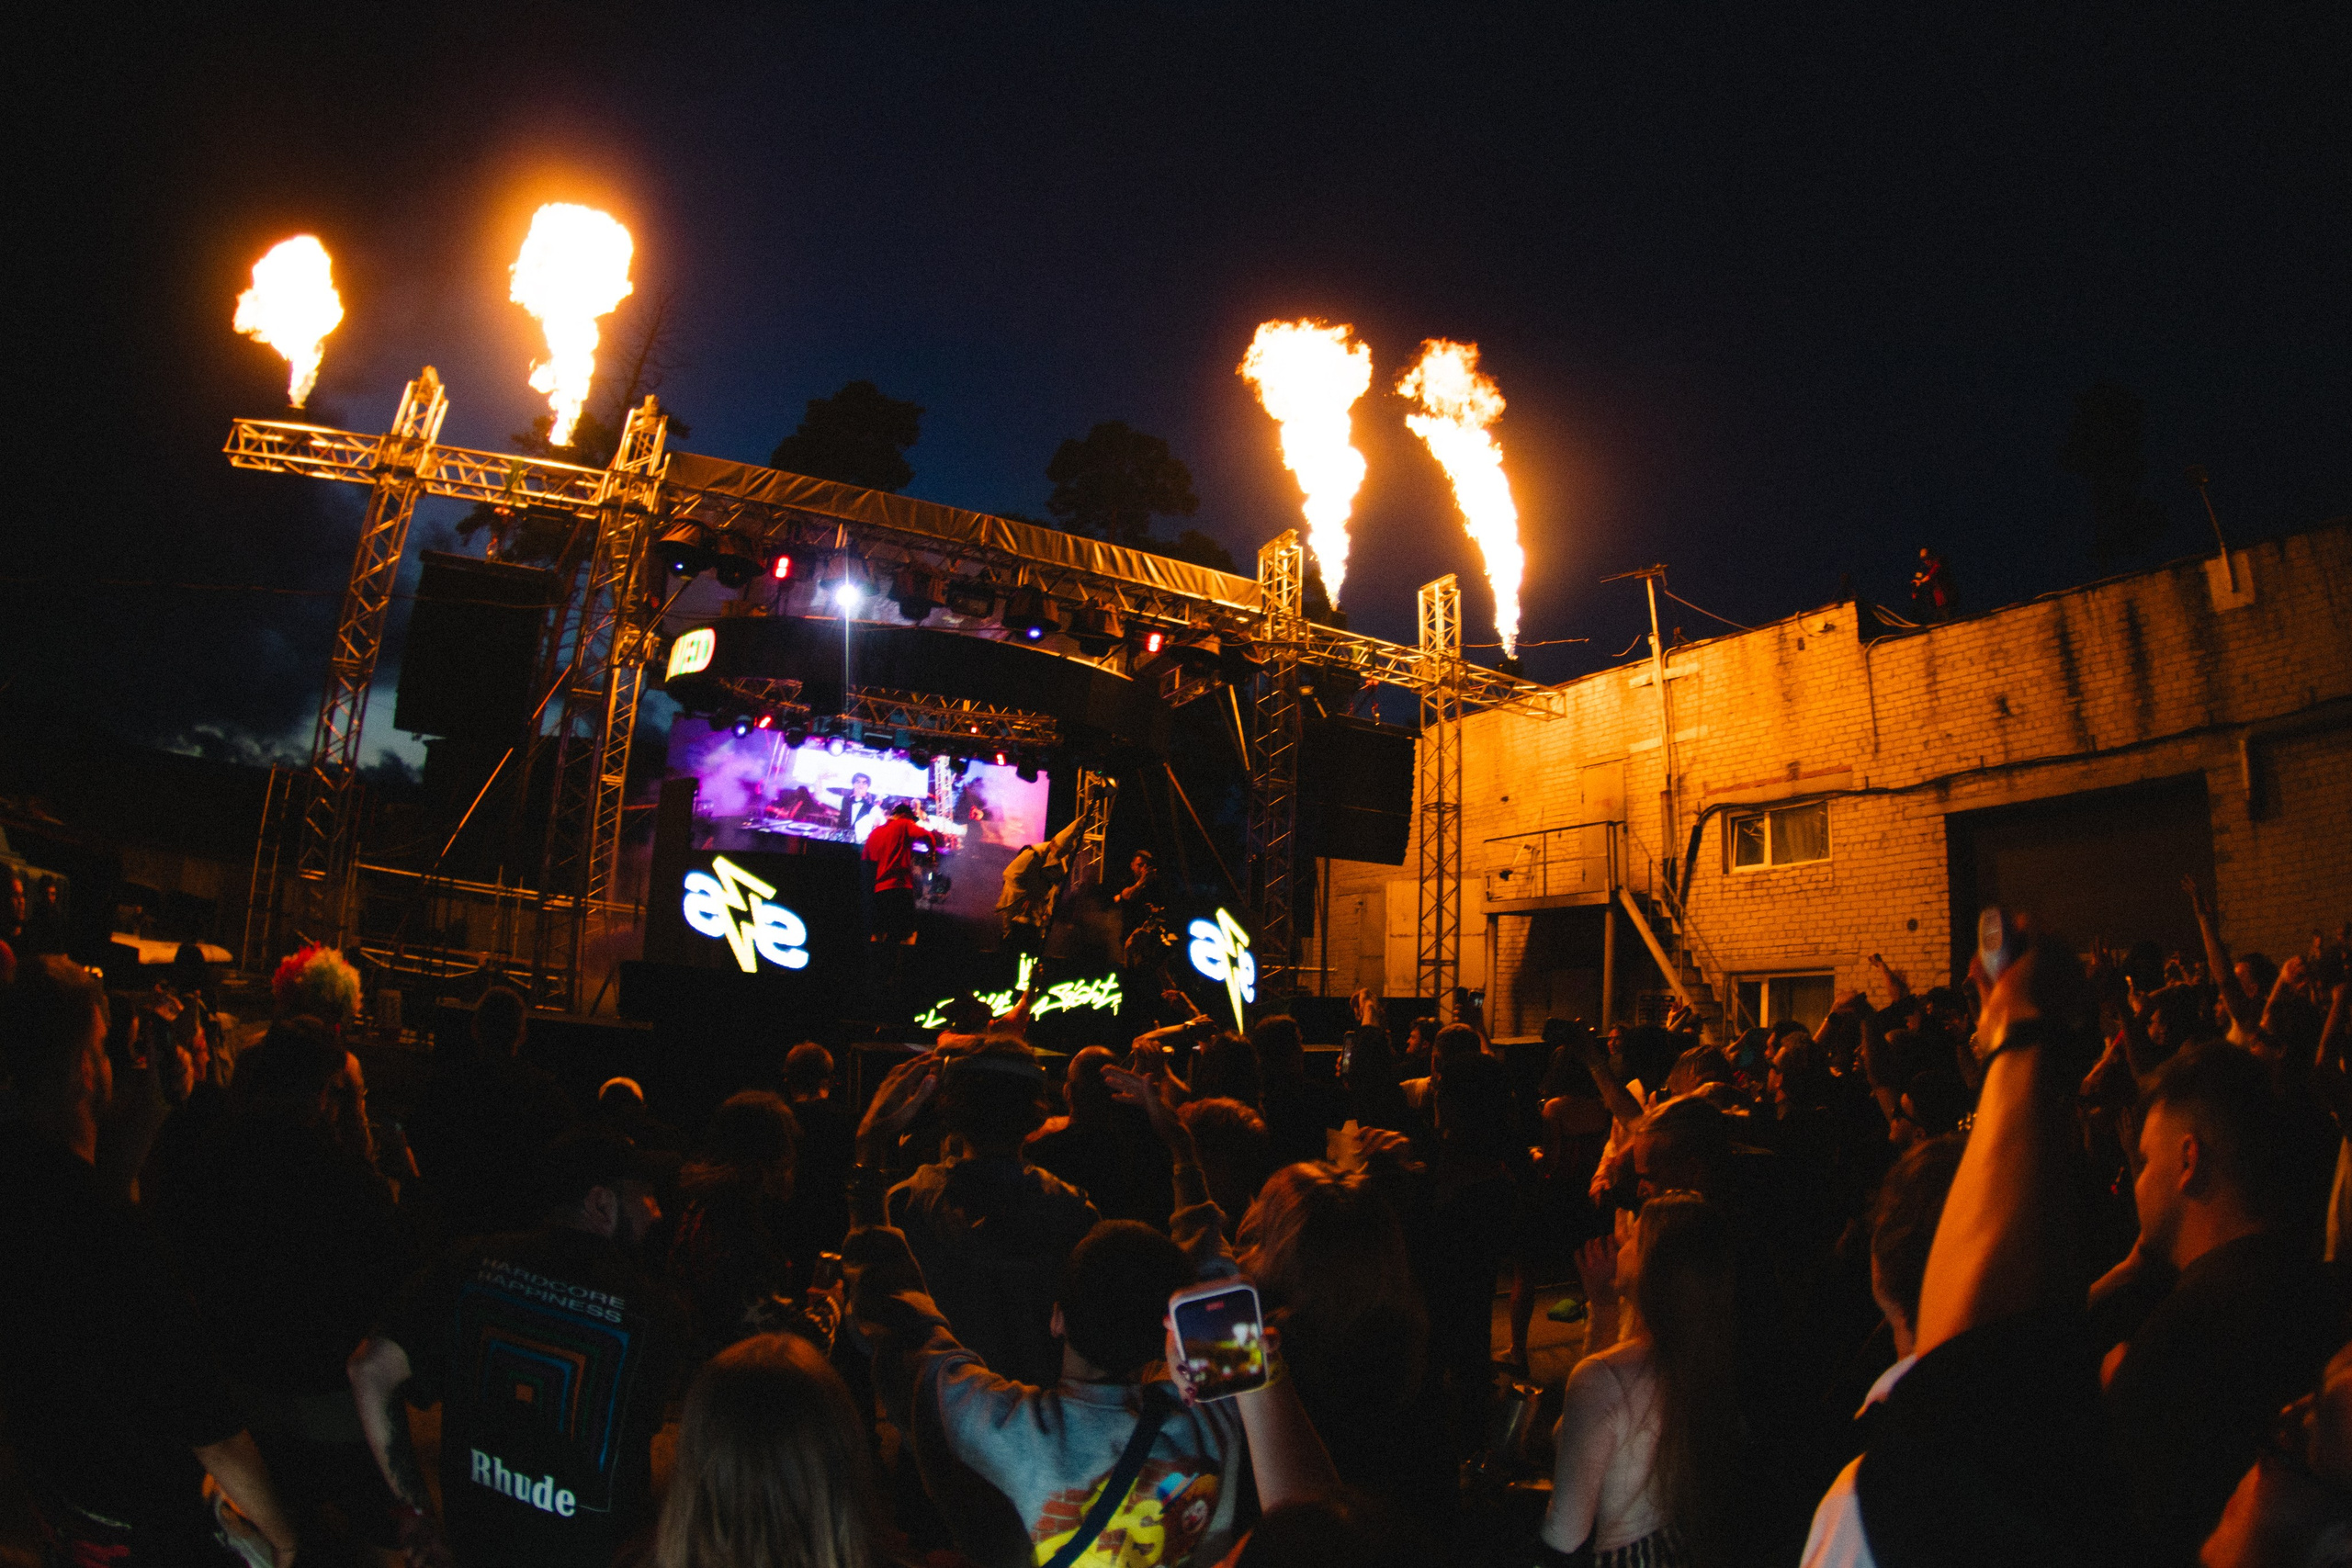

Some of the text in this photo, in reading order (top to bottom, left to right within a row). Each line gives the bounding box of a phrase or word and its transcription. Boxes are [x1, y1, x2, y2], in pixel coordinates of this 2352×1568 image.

[477, 1270, 623, 1324] HAPPINESS
[481, 1258, 627, 1311] HARDCORE
[469, 1448, 577, 1517] Rhude
